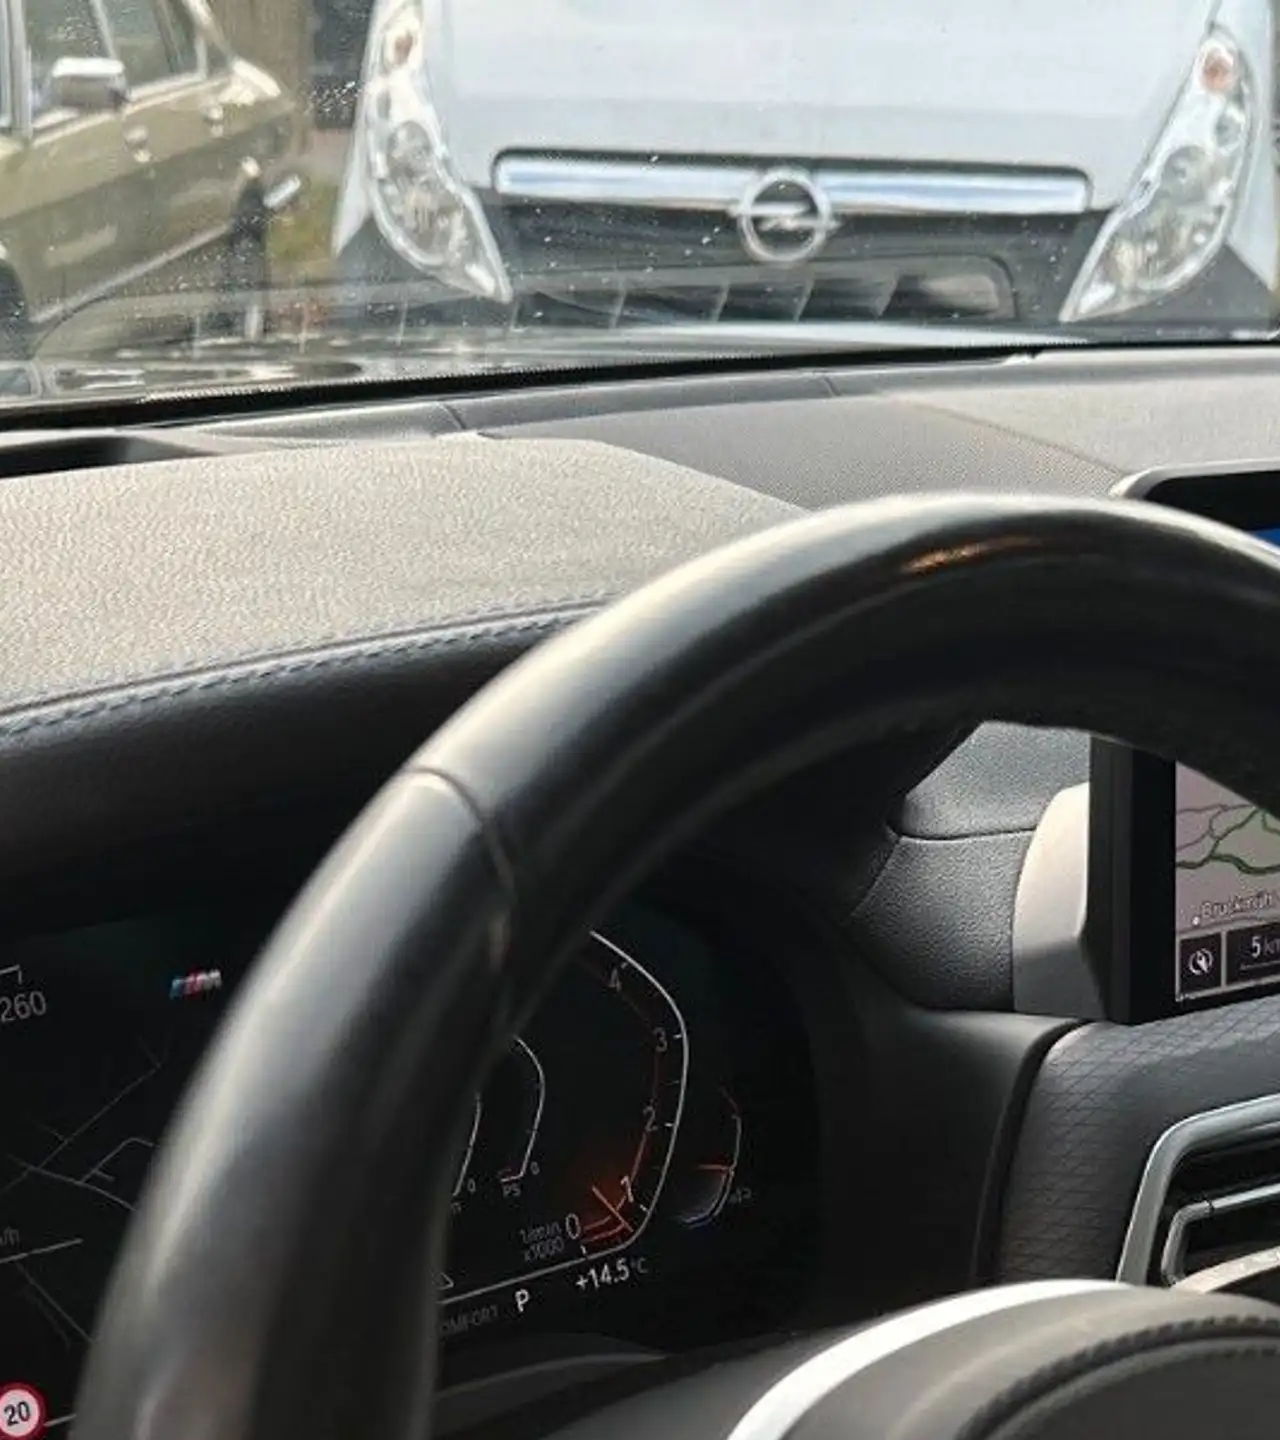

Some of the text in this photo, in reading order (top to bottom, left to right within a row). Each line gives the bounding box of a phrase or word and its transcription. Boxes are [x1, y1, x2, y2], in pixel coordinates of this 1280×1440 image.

[1250, 934, 1262, 958] 5
[653, 1026, 668, 1052] 3
[643, 1105, 658, 1132] 2
[620, 1174, 634, 1203] 1
[565, 1213, 581, 1240] 0
[514, 1287, 530, 1313] P
[3, 1400, 32, 1428] 20
